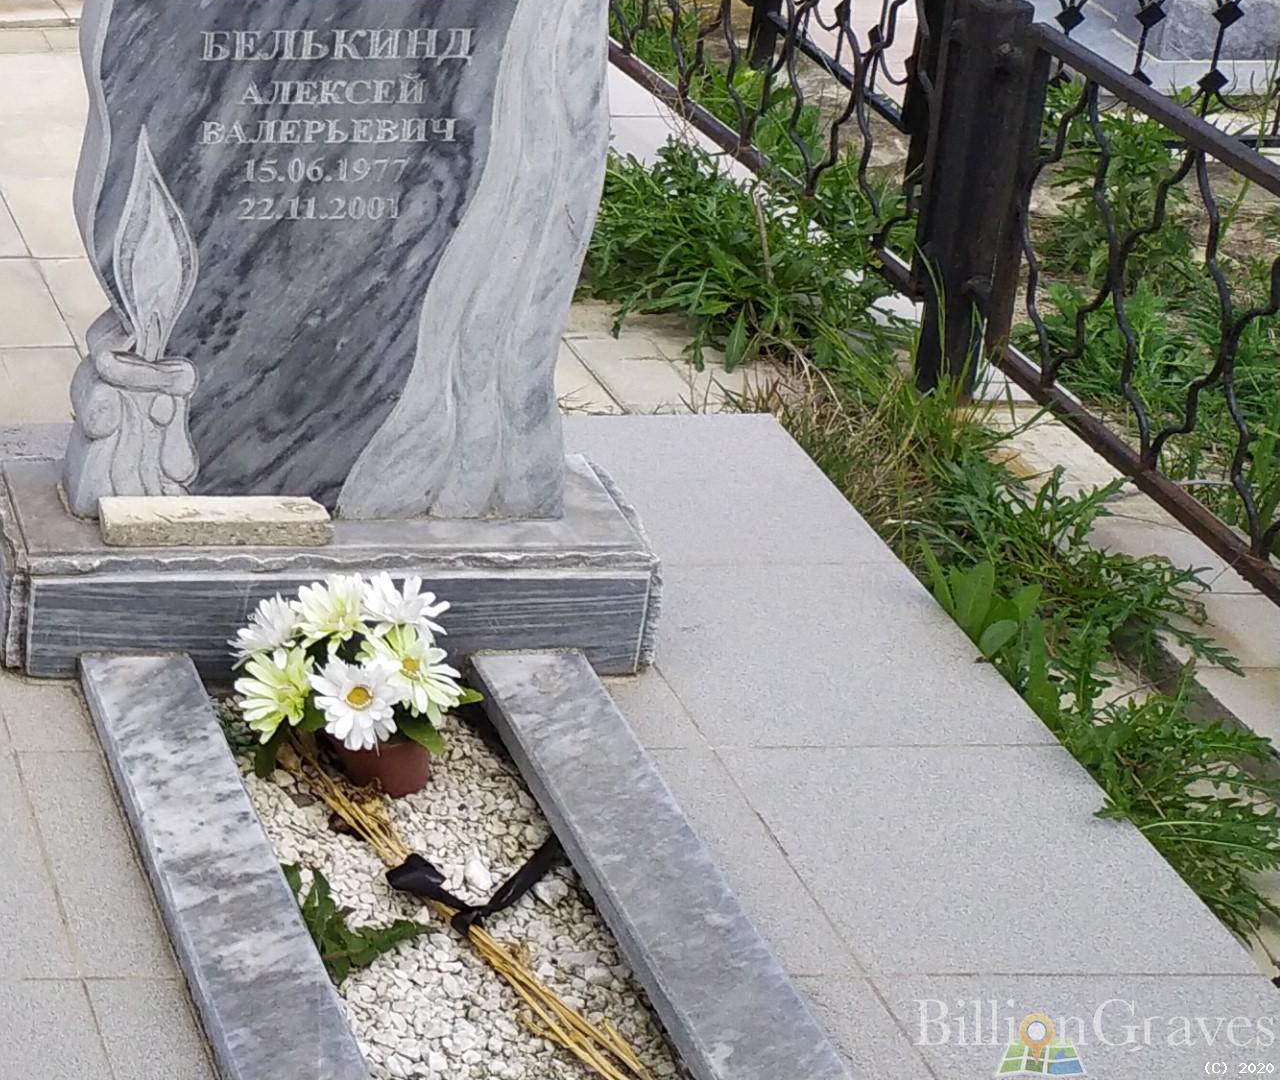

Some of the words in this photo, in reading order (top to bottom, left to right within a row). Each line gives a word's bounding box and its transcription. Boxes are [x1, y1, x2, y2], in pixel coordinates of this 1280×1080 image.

[199, 27, 476, 66] БЕЛЬКИНД
[237, 73, 427, 106] АЛЕКСЕЙ
[200, 118, 458, 146] ВАЛЕРЬЕВИЧ
[244, 157, 410, 184] 15.06.1977
[237, 196, 401, 222] 22.11.2001
